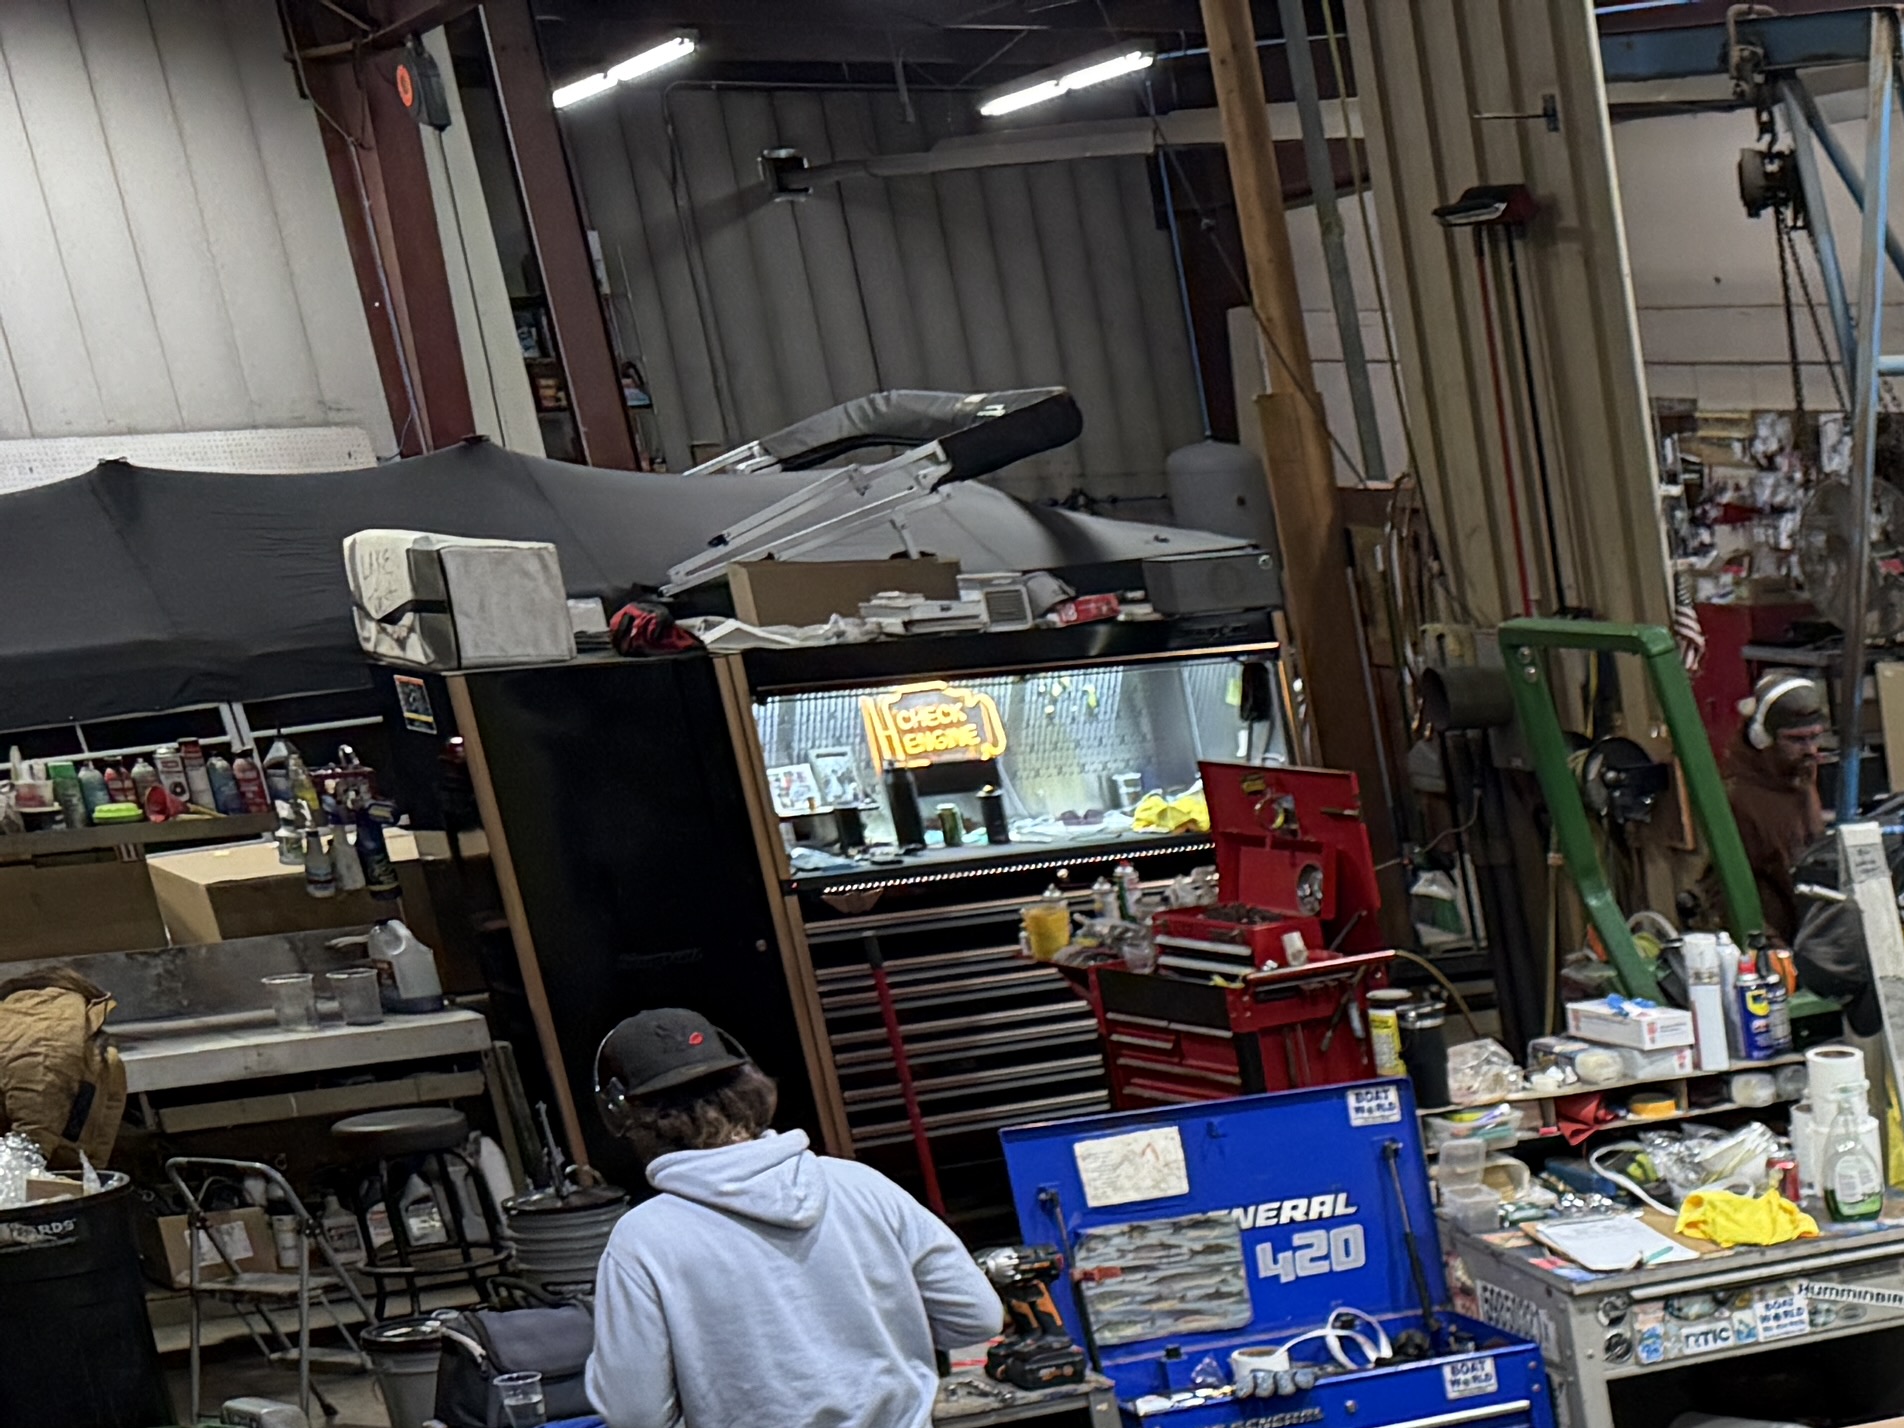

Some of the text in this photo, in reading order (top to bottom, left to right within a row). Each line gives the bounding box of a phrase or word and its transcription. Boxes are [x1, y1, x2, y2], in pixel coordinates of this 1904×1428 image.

[896, 702, 967, 730] CHECK
[902, 723, 981, 754] ENGINE
[1256, 1224, 1366, 1284] 420
